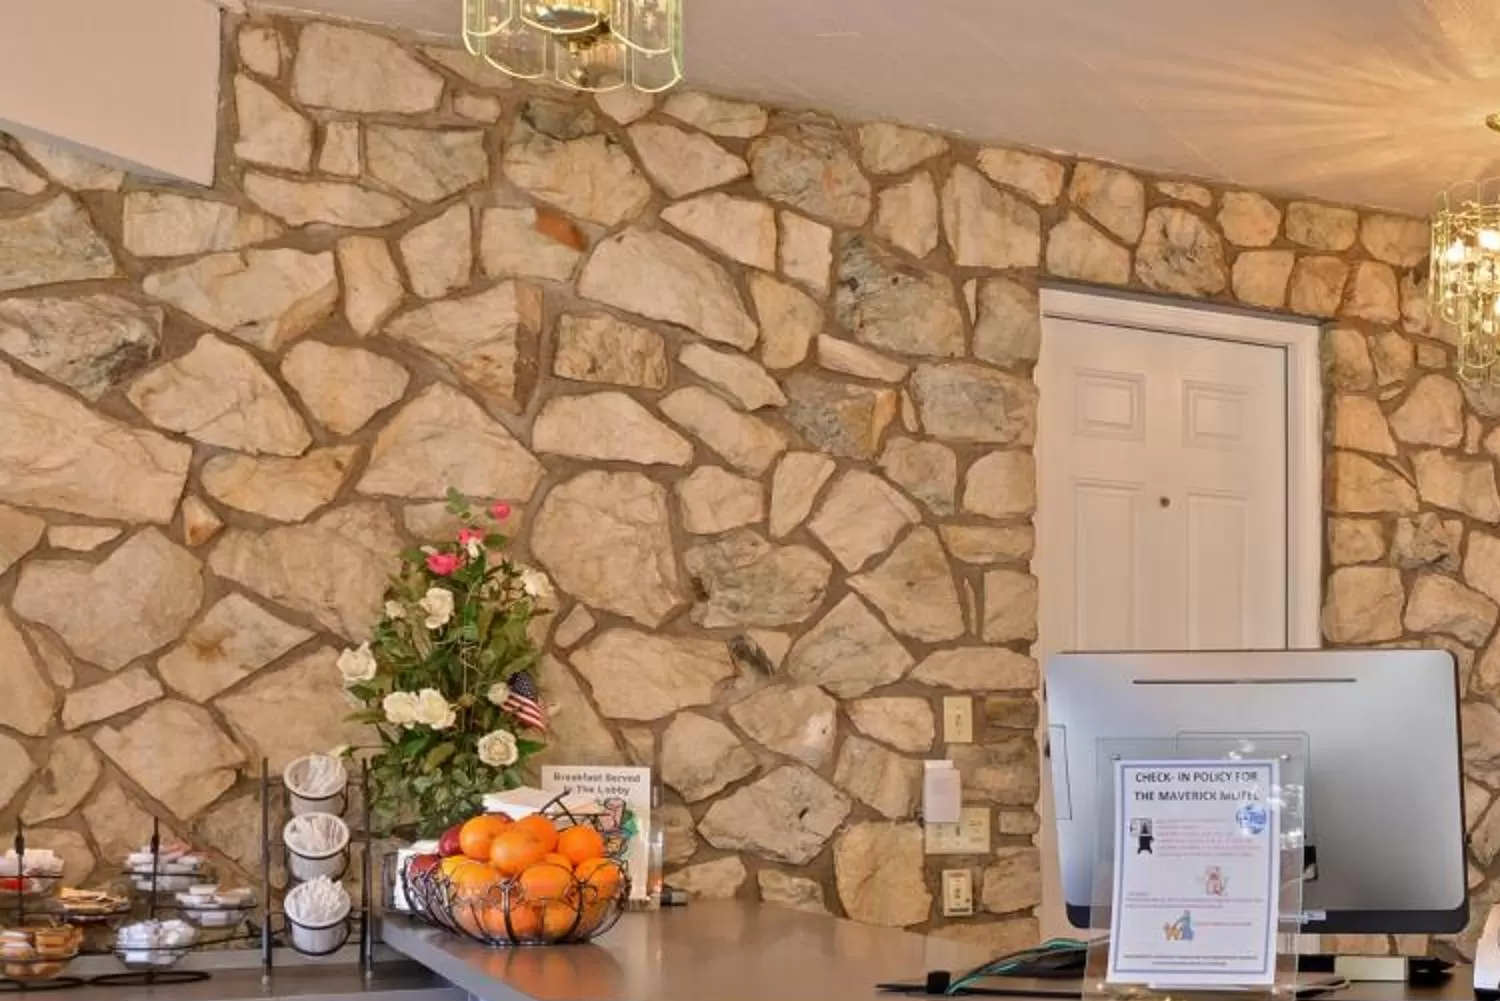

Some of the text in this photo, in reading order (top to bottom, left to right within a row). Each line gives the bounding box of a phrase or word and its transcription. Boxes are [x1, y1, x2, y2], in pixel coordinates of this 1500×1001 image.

[553, 771, 641, 783] Breakfast Served
[1177, 771, 1191, 783] IN
[1193, 771, 1233, 783] POLICY
[1235, 771, 1257, 783] FOR
[576, 785, 595, 794] The
[597, 785, 631, 796] Lobby
[1134, 790, 1154, 801] THE
[1158, 790, 1217, 801] MAVERICK
